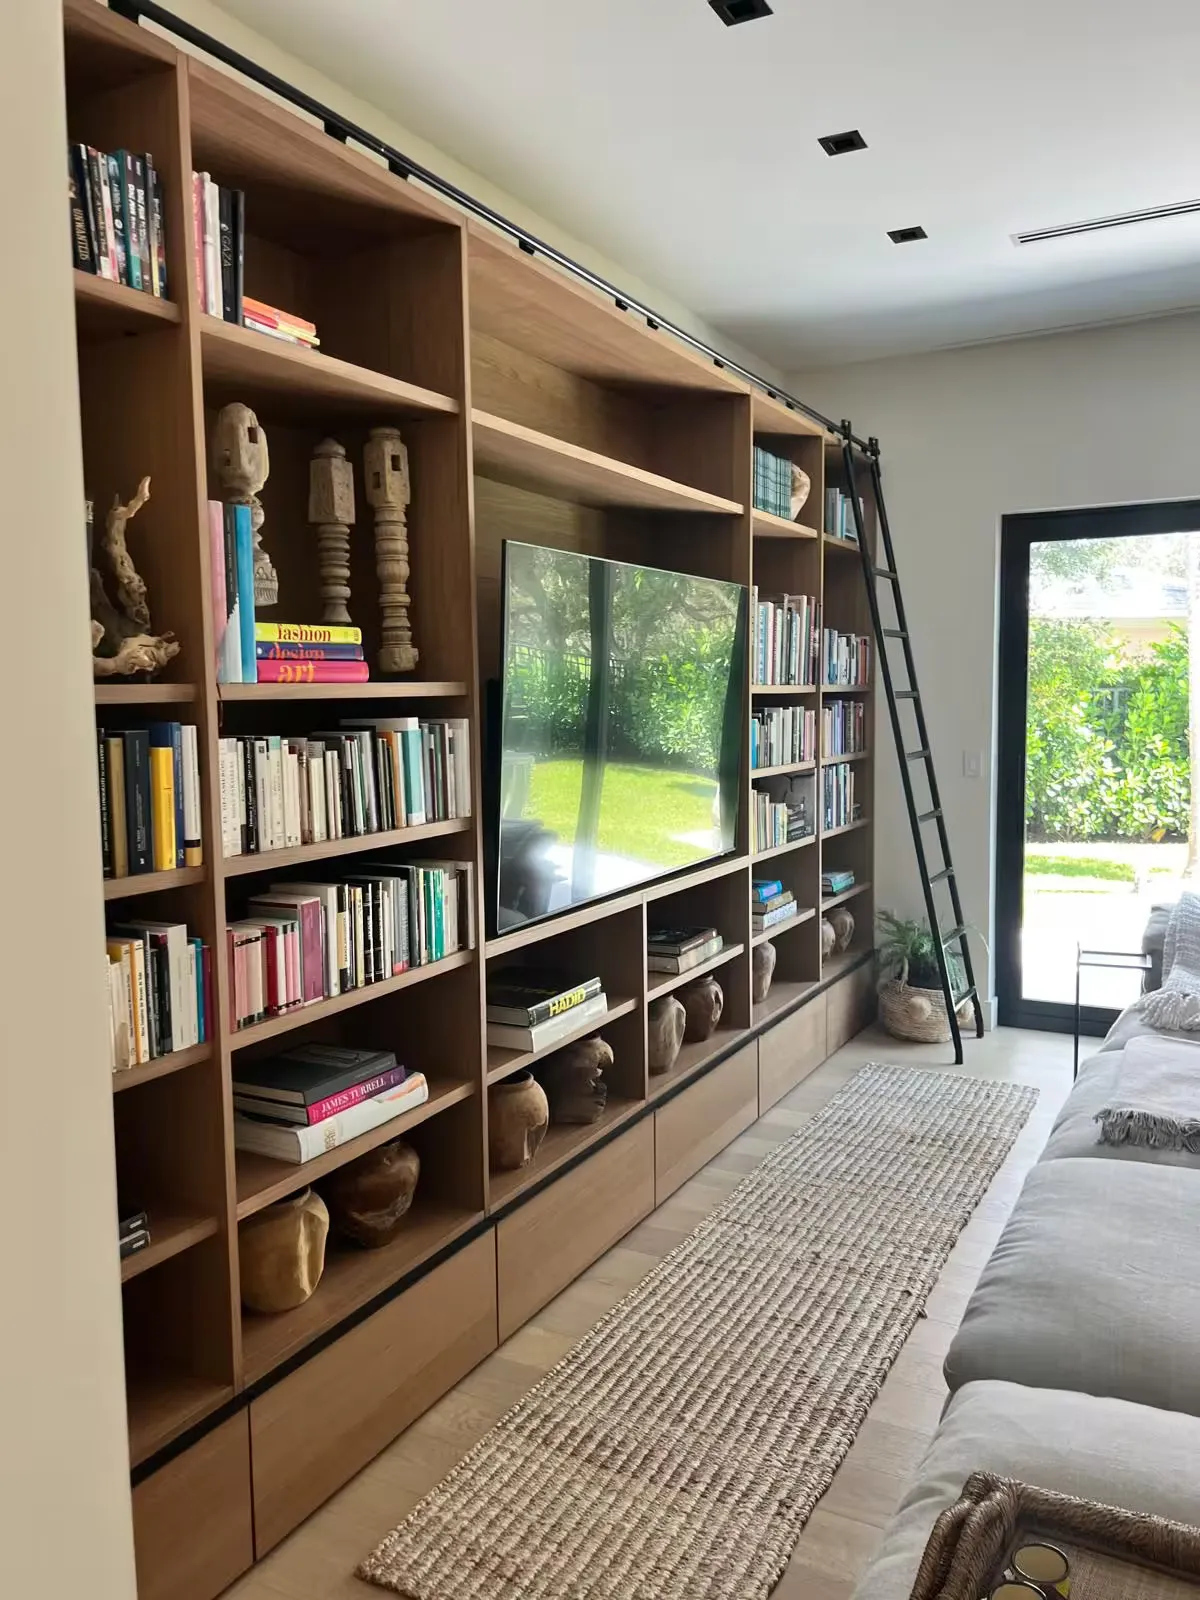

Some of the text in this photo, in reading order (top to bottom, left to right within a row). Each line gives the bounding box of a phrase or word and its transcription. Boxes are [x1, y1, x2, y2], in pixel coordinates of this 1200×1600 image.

[222, 235, 232, 267] GAZA
[277, 624, 331, 642] fashion
[278, 661, 316, 682] art
[548, 987, 587, 1017] HADID
[321, 1077, 387, 1113] JAMES TURRELL
